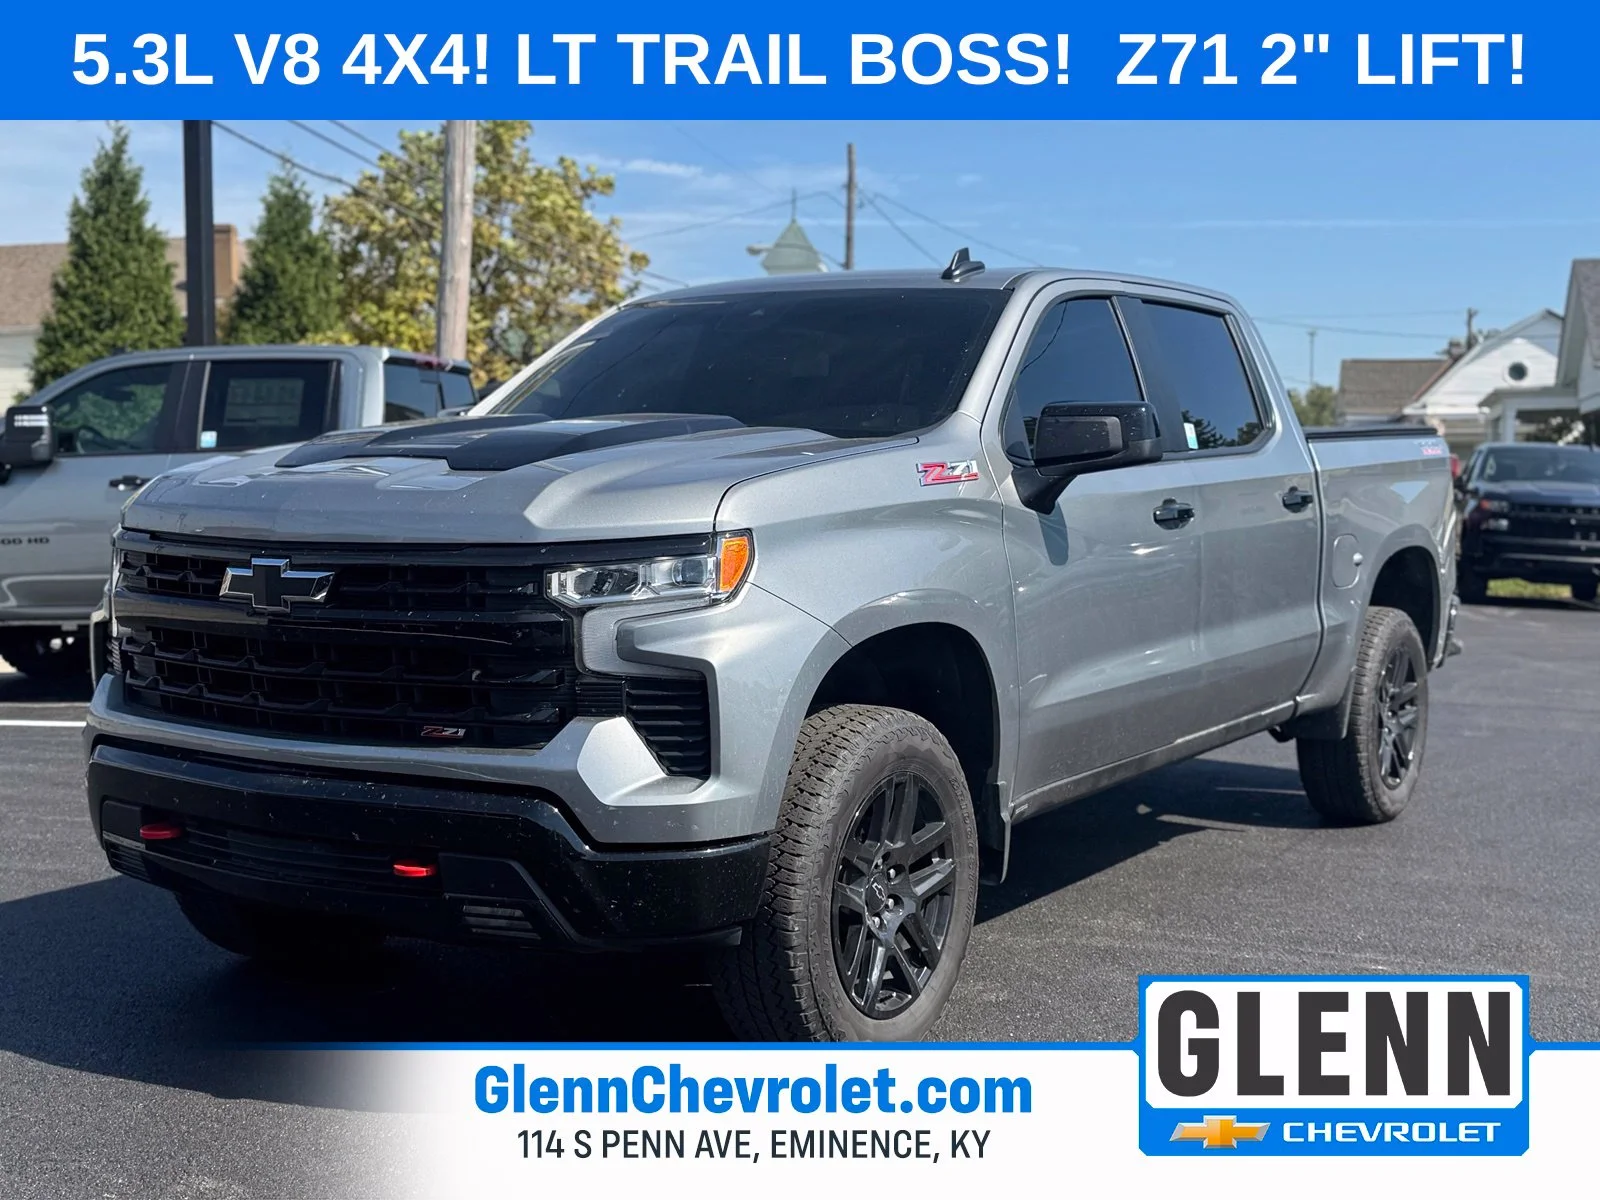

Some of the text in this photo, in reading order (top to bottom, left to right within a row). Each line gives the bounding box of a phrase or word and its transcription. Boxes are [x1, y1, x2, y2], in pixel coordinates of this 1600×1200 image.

[916, 460, 980, 486] Z71
[27, 536, 50, 545] HD
[420, 725, 466, 739] Z71
